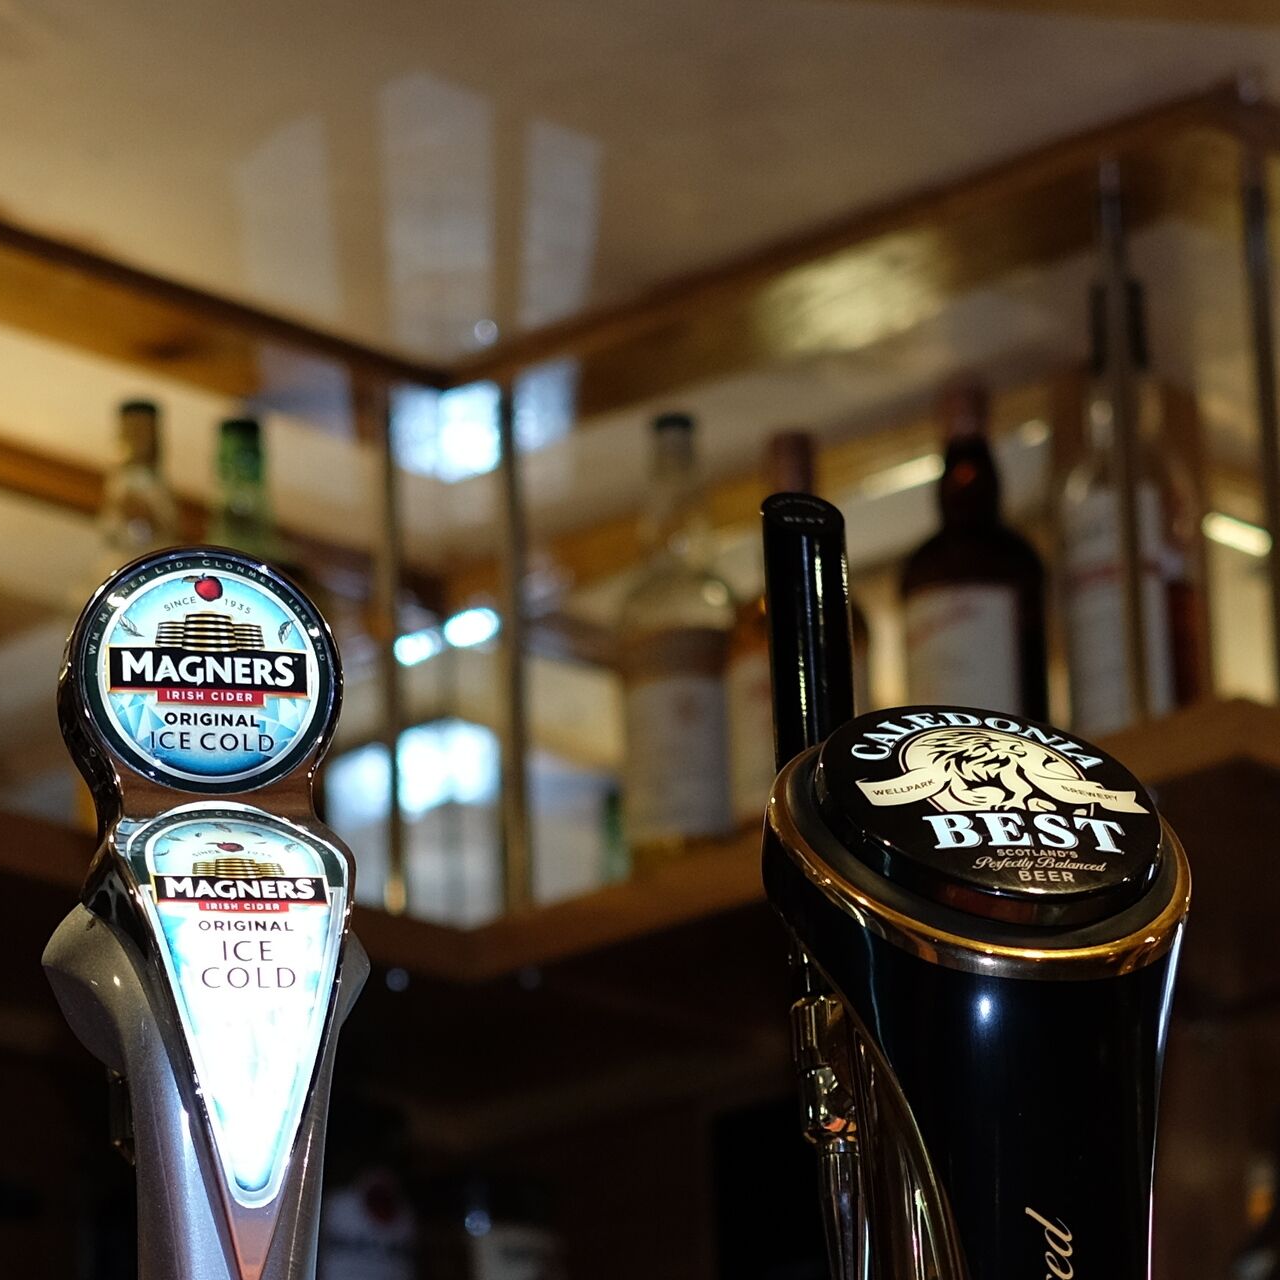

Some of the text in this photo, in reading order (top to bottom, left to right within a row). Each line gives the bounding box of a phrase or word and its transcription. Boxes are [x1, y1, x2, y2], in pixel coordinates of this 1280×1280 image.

[99, 575, 147, 623] MANER
[164, 596, 251, 614] SINCE 1935
[120, 650, 295, 687] MAGNERS
[166, 690, 253, 702] IRISH CIDER
[164, 712, 261, 729] ORIGINAL
[150, 731, 274, 753] ICE COLD
[850, 711, 1104, 771] CALEDONIA
[873, 778, 1119, 802] WELLPARK BREWERY
[921, 811, 1127, 855] BEST
[996, 848, 1079, 859] SCOTLAND'S
[972, 856, 1108, 873] Perfectly Balanced
[1018, 869, 1076, 883] BEER
[163, 876, 316, 900] MAGNERS
[205, 902, 280, 911] IRISH CIDER
[198, 920, 294, 932] ORIGINAL
[222, 941, 273, 961] ICE
[201, 967, 296, 989] COLD
